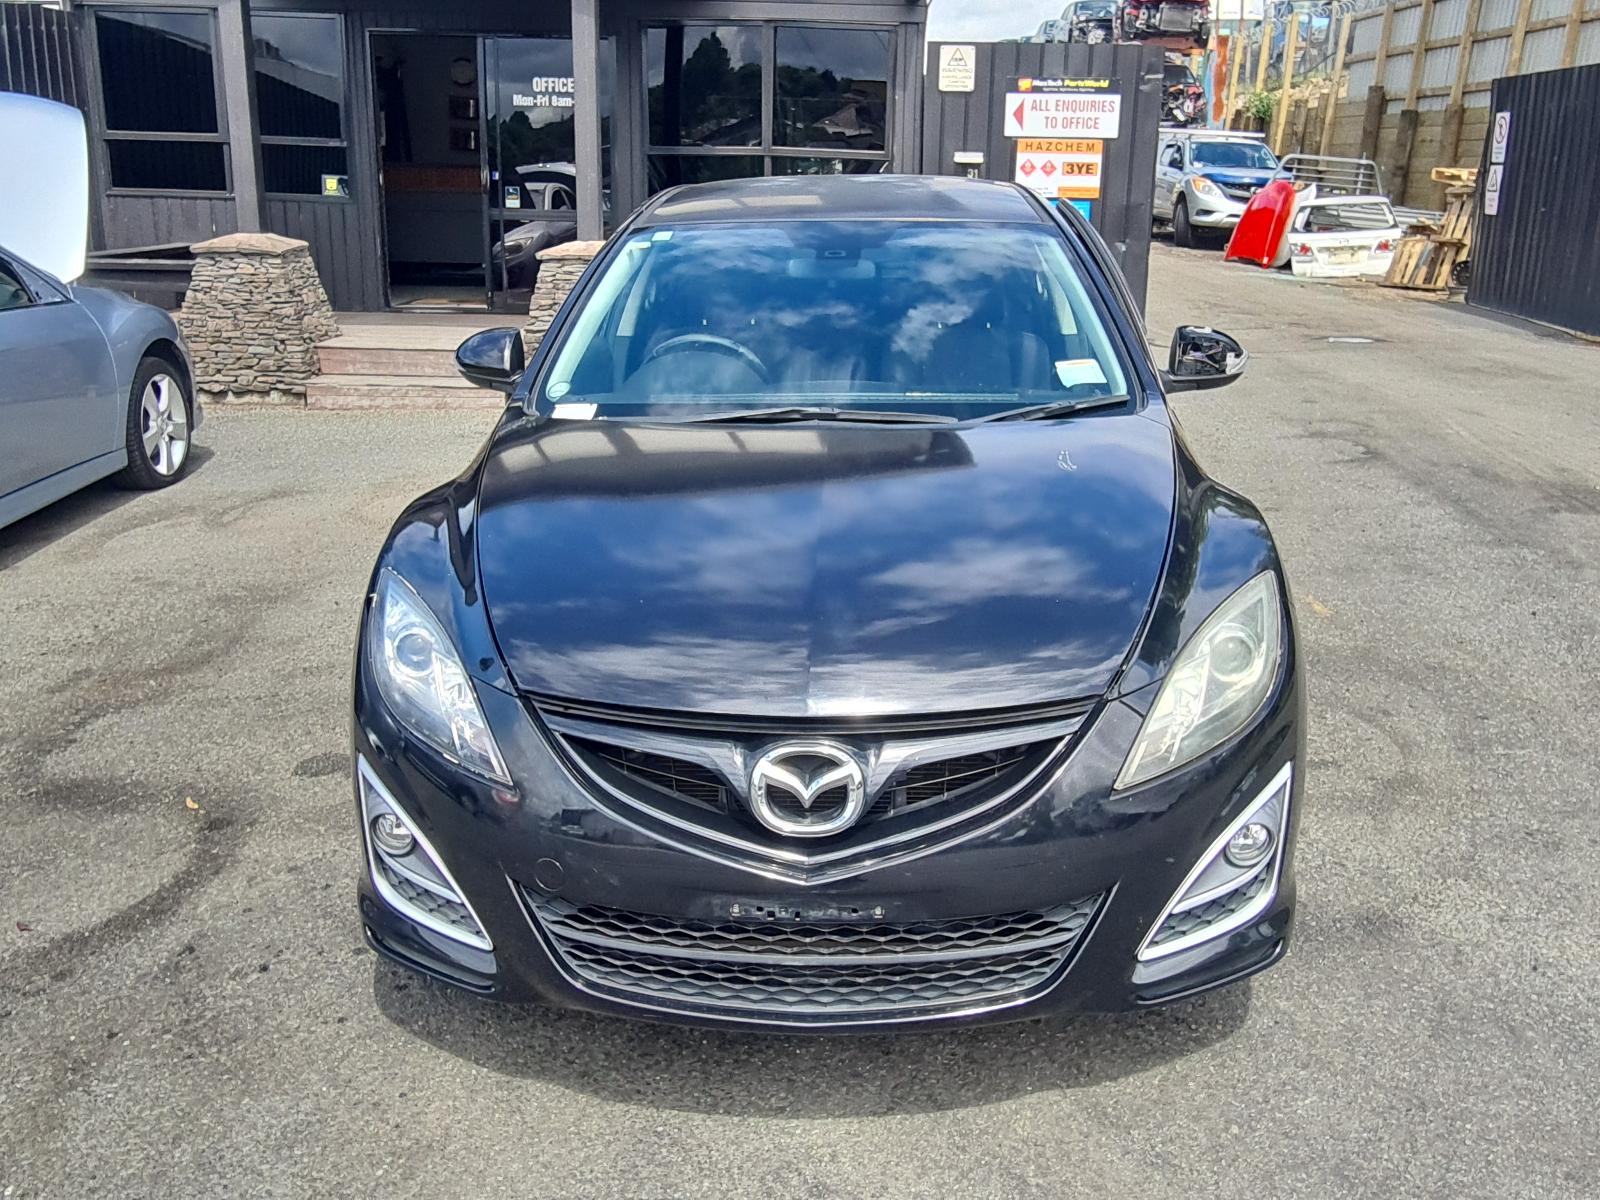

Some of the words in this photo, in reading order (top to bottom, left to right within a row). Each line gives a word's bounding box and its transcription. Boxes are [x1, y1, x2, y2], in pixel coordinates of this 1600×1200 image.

[533, 77, 574, 92] OFFICE
[513, 94, 549, 106] Mon-Fri
[1031, 99, 1051, 112] ALL
[1055, 100, 1115, 113] ENQUIRIES
[1044, 116, 1057, 129] TO
[1062, 117, 1100, 129] OFFICE
[1025, 142, 1095, 152] HAZCHEM
[967, 168, 979, 179] 31
[1066, 164, 1094, 175] 3YE
